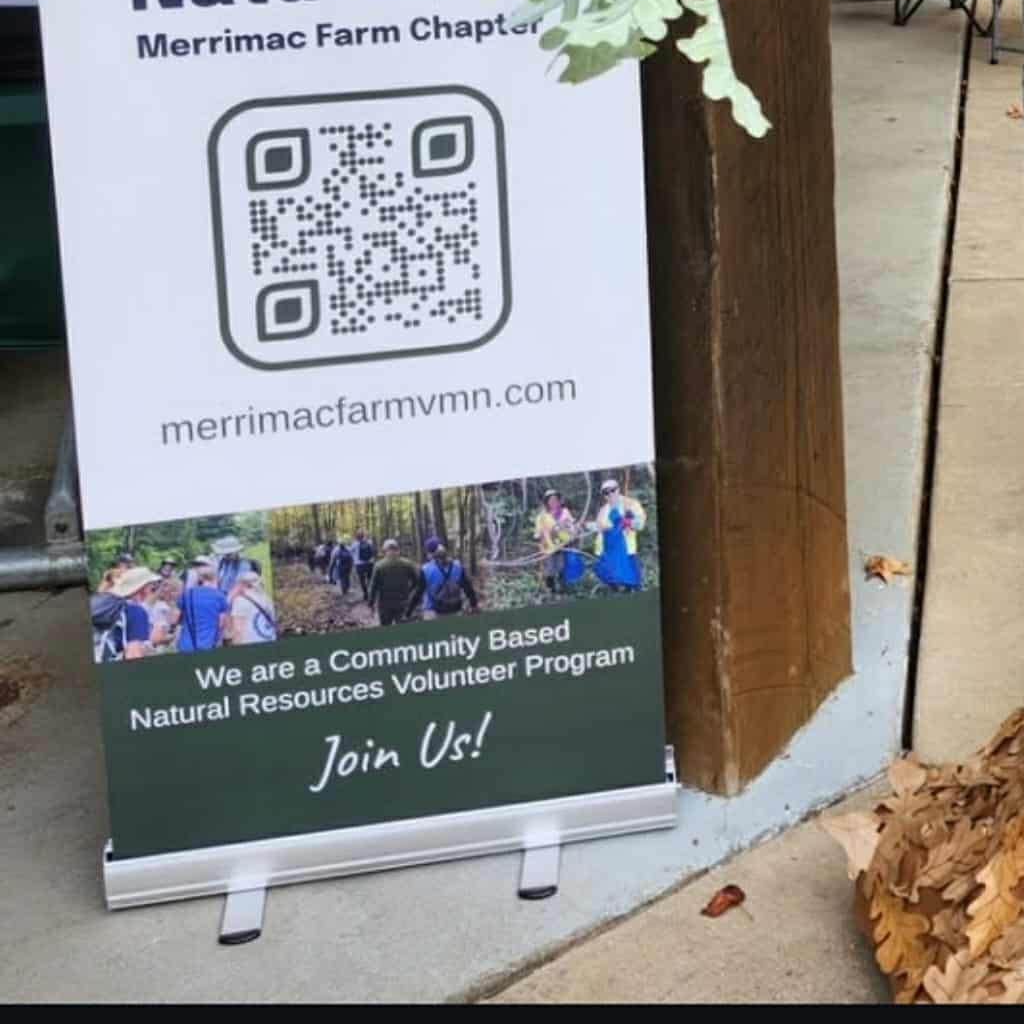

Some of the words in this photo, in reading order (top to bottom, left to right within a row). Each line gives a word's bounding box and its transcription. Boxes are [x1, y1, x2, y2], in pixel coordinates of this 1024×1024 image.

[136, 28, 307, 59] Merrimac
[316, 22, 401, 48] Farm
[161, 379, 577, 445] merrimacfarmvmn.com
[130, 695, 230, 731] Natural
[239, 680, 385, 716] Resources
[391, 661, 518, 695] Volunteer
[524, 645, 635, 677] Program
[194, 665, 243, 690] We
[251, 661, 295, 683] are
[304, 657, 322, 677] a
[329, 633, 481, 673] Community
[488, 618, 571, 651] Based
[309, 734, 401, 793] Join
[420, 711, 493, 769] Us!
